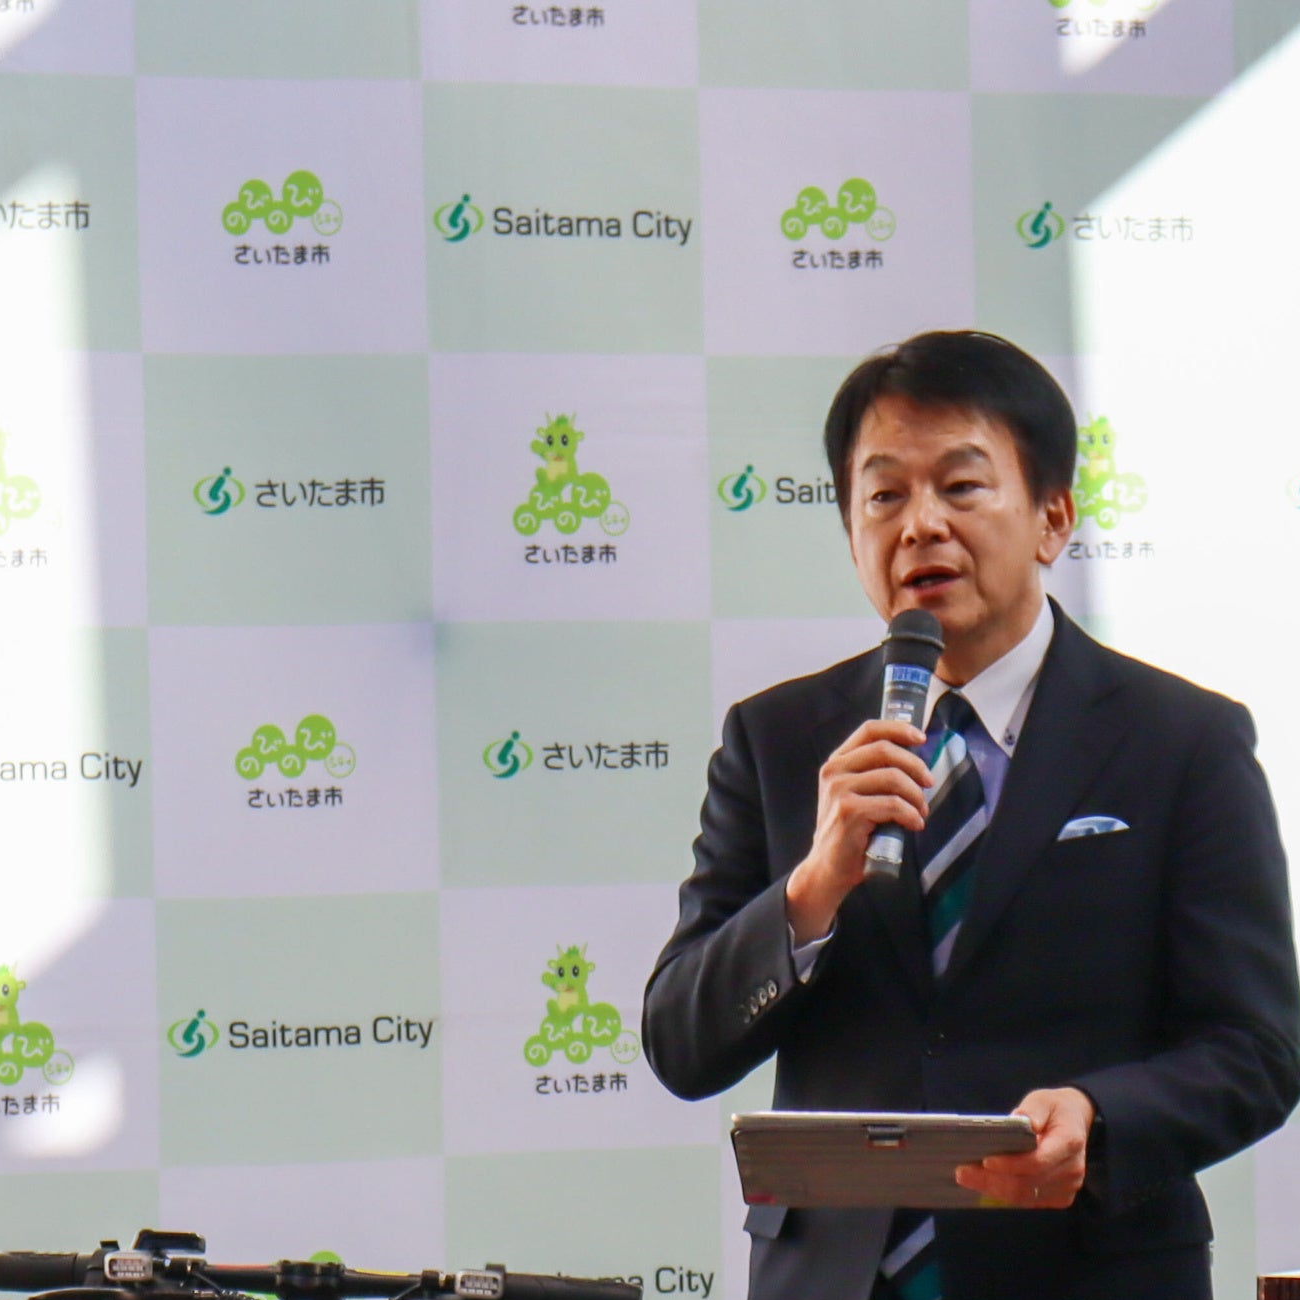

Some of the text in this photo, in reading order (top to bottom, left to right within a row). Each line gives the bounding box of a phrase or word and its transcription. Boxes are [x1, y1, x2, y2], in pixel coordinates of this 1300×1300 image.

[512, 6, 604, 28] さいたま市
[1056, 17, 1147, 39] さいたま市
[226, 182, 319, 229] のびのび
[784, 189, 873, 233] のびのび
[493, 207, 692, 246] Saitama City
[1072, 213, 1194, 243] さいたま市
[234, 243, 330, 266] さいたま市
[792, 250, 884, 270] さいたま市
[254, 478, 385, 507] さいたま市
[776, 477, 837, 503] Sait
[517, 484, 607, 529] のびのび
[524, 544, 617, 565] さいたま市
[1068, 540, 1155, 560] さいたま市
[238, 726, 332, 773] のびのび
[543, 741, 669, 769] さいたま市
[79, 751, 143, 788] City
[247, 787, 342, 809] さいたま市
[228, 1015, 434, 1050] Saitama City
[527, 1015, 618, 1060] のびのび
[535, 1072, 628, 1095] さいたま市
[655, 1267, 714, 1299] City
